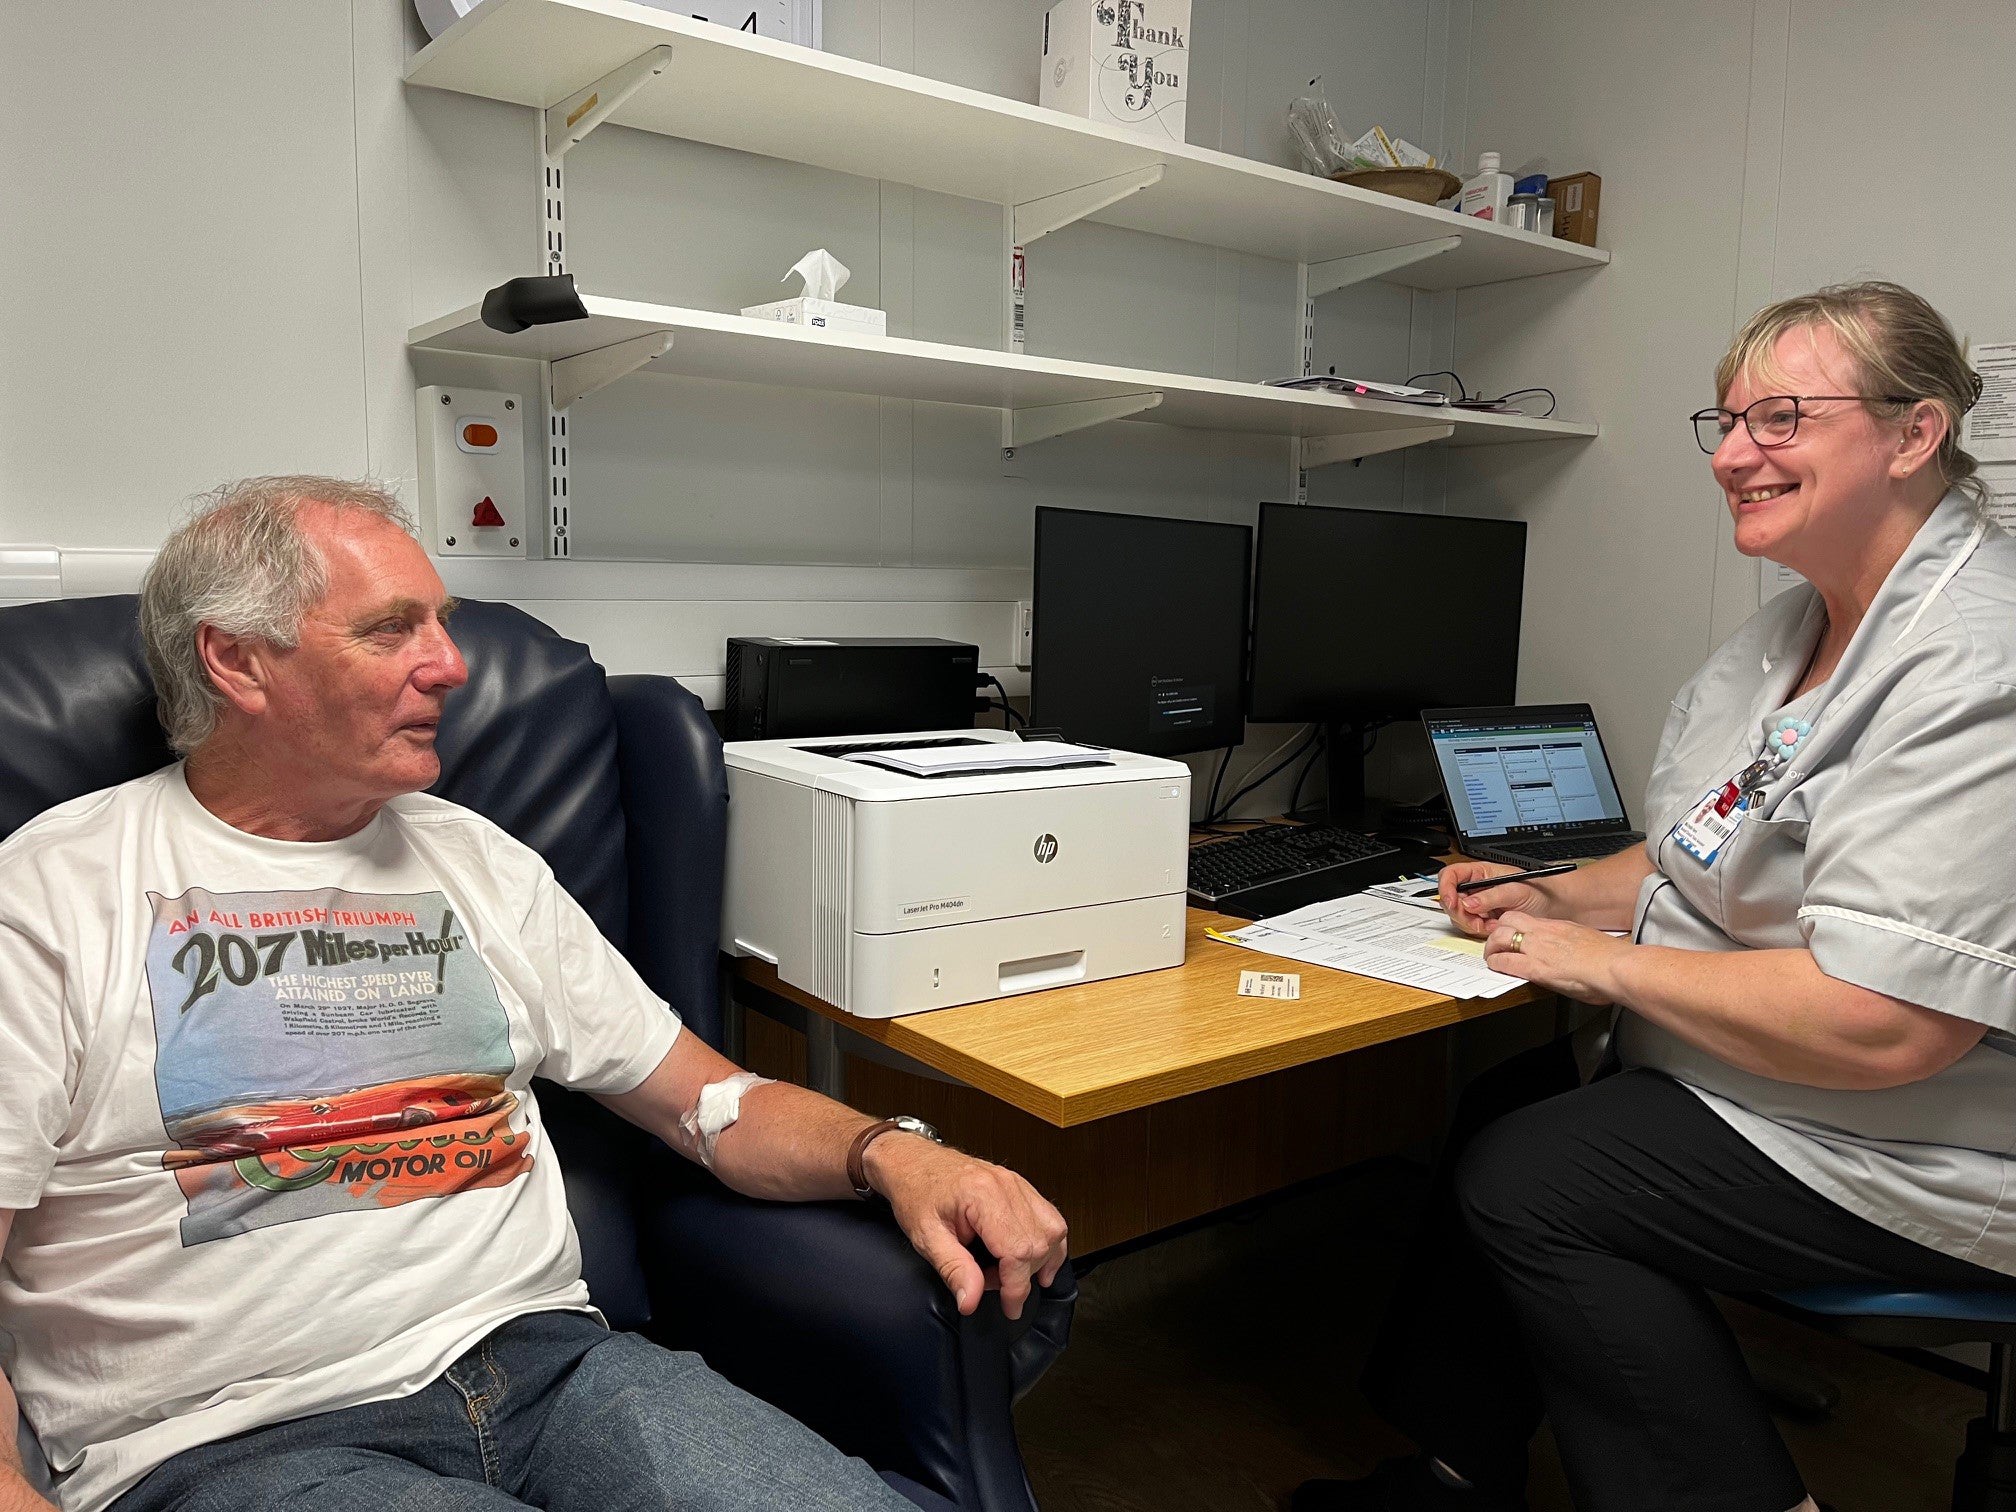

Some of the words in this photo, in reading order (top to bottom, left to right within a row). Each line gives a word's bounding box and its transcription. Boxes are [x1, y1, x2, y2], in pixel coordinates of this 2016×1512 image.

[1097, 0, 1184, 50] Thank
[1036, 833, 1056, 863] hp
[169, 909, 200, 935] AN
[209, 910, 243, 928] ALL
[249, 907, 328, 928] BRITISH
[333, 910, 417, 927] TRIUMPH
[903, 905, 928, 915] LaserJet
[929, 903, 940, 911] Pro
[171, 931, 298, 1015] 207
[300, 929, 379, 967] Miles
[377, 941, 410, 964] per
[268, 974, 298, 988] THE
[302, 974, 357, 990] HIGHEST
[361, 972, 398, 987] SPEED
[401, 971, 433, 983] EVER
[275, 986, 347, 1002] ATTAINED
[354, 986, 380, 1000] ON
[389, 982, 436, 998] LAND
[340, 1154, 446, 1184] MOTOR
